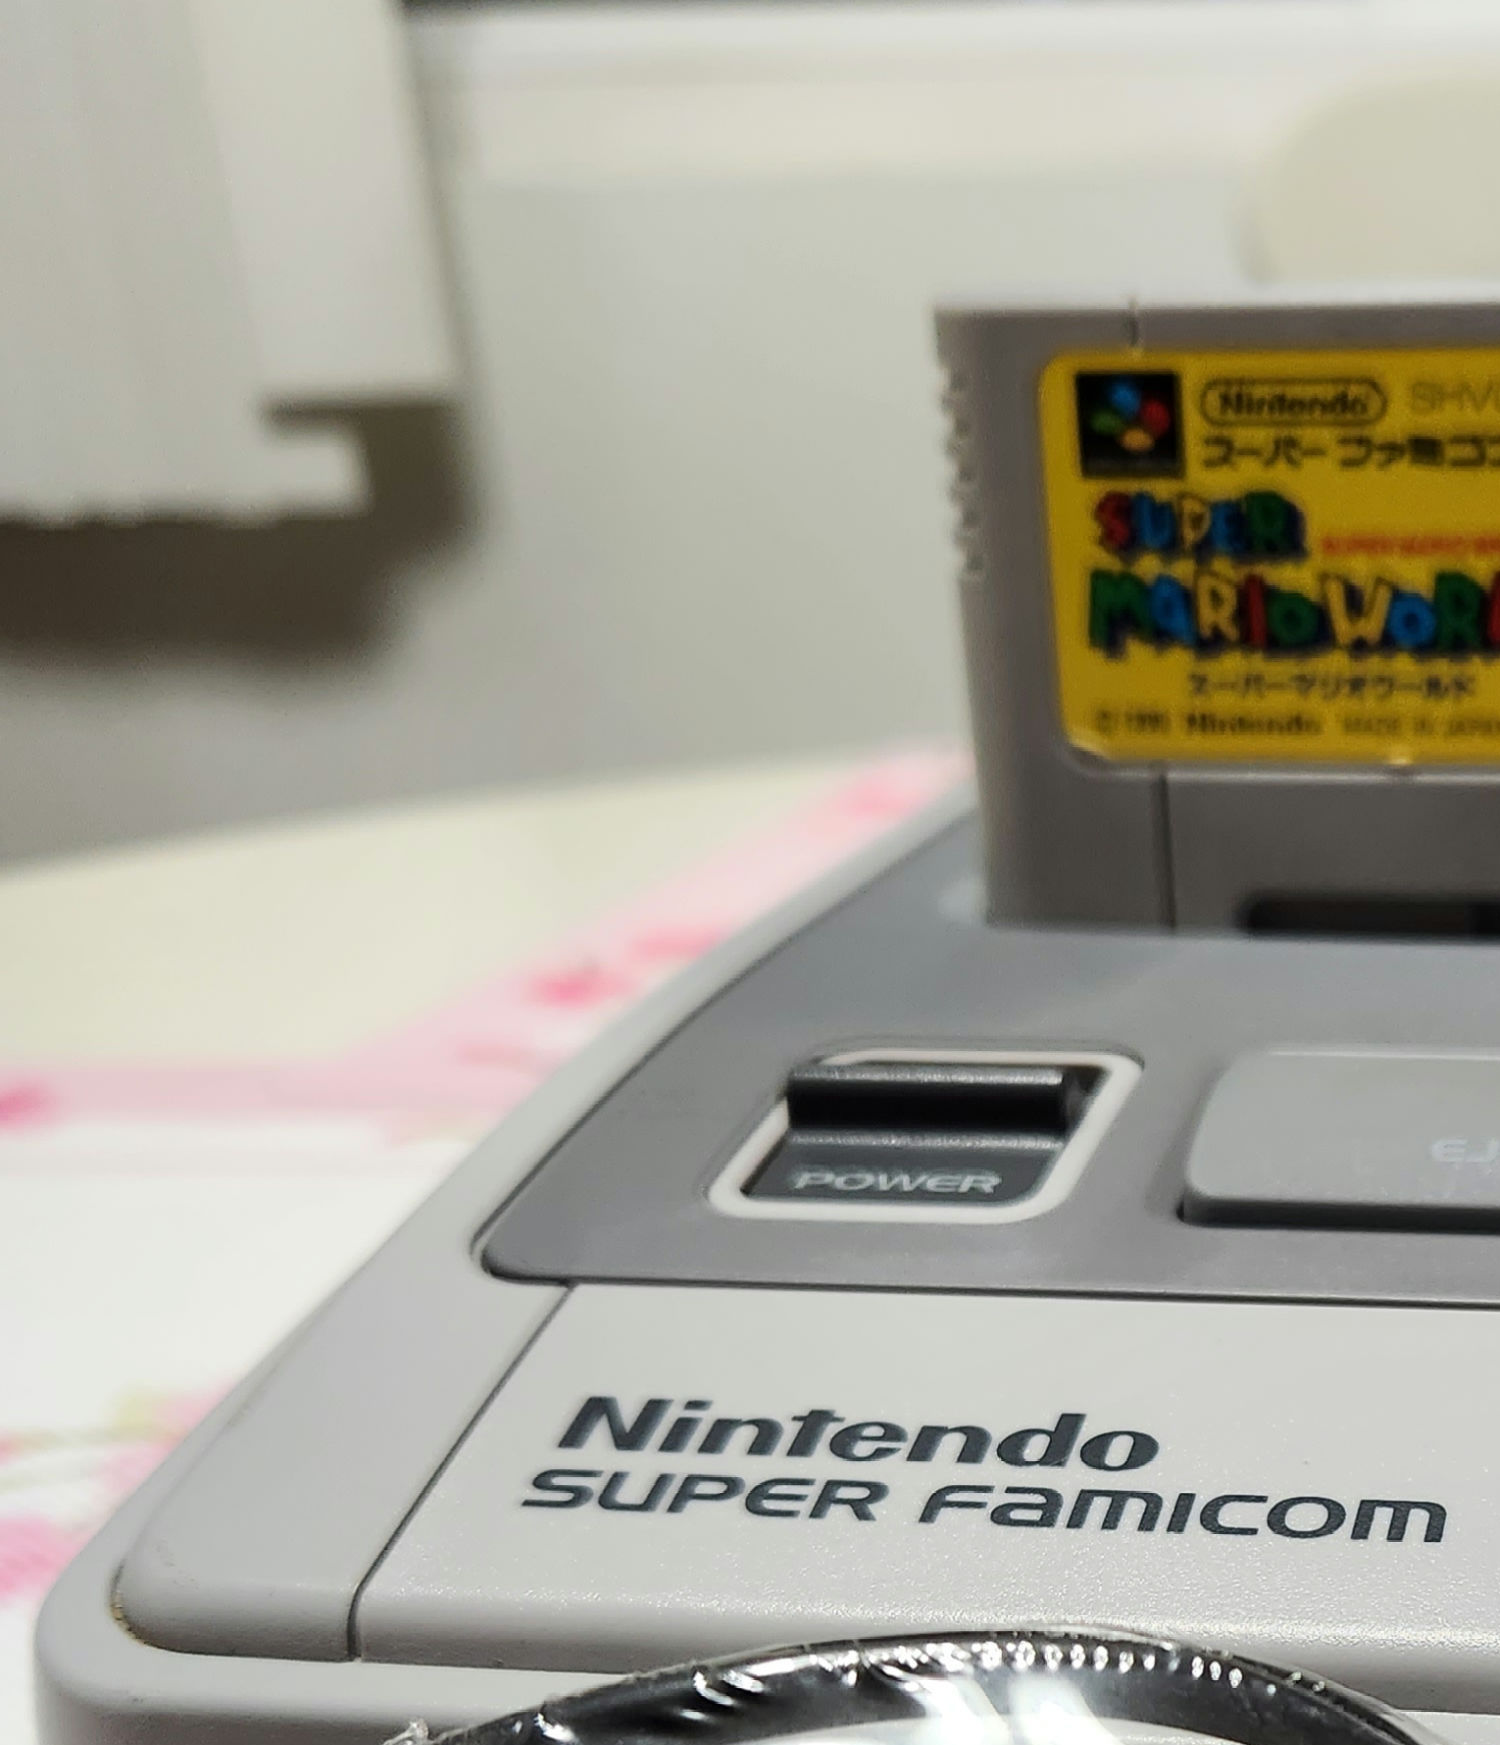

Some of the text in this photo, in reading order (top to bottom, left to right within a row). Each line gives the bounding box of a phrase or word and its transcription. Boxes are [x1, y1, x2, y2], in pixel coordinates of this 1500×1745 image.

[1217, 388, 1371, 418] Nintendo
[1093, 490, 1307, 560] SUPER
[1089, 568, 1325, 660] MARIO
[792, 1168, 1003, 1194] POWER
[556, 1395, 1161, 1472] Nintendo
[521, 1468, 890, 1523] SUPER
